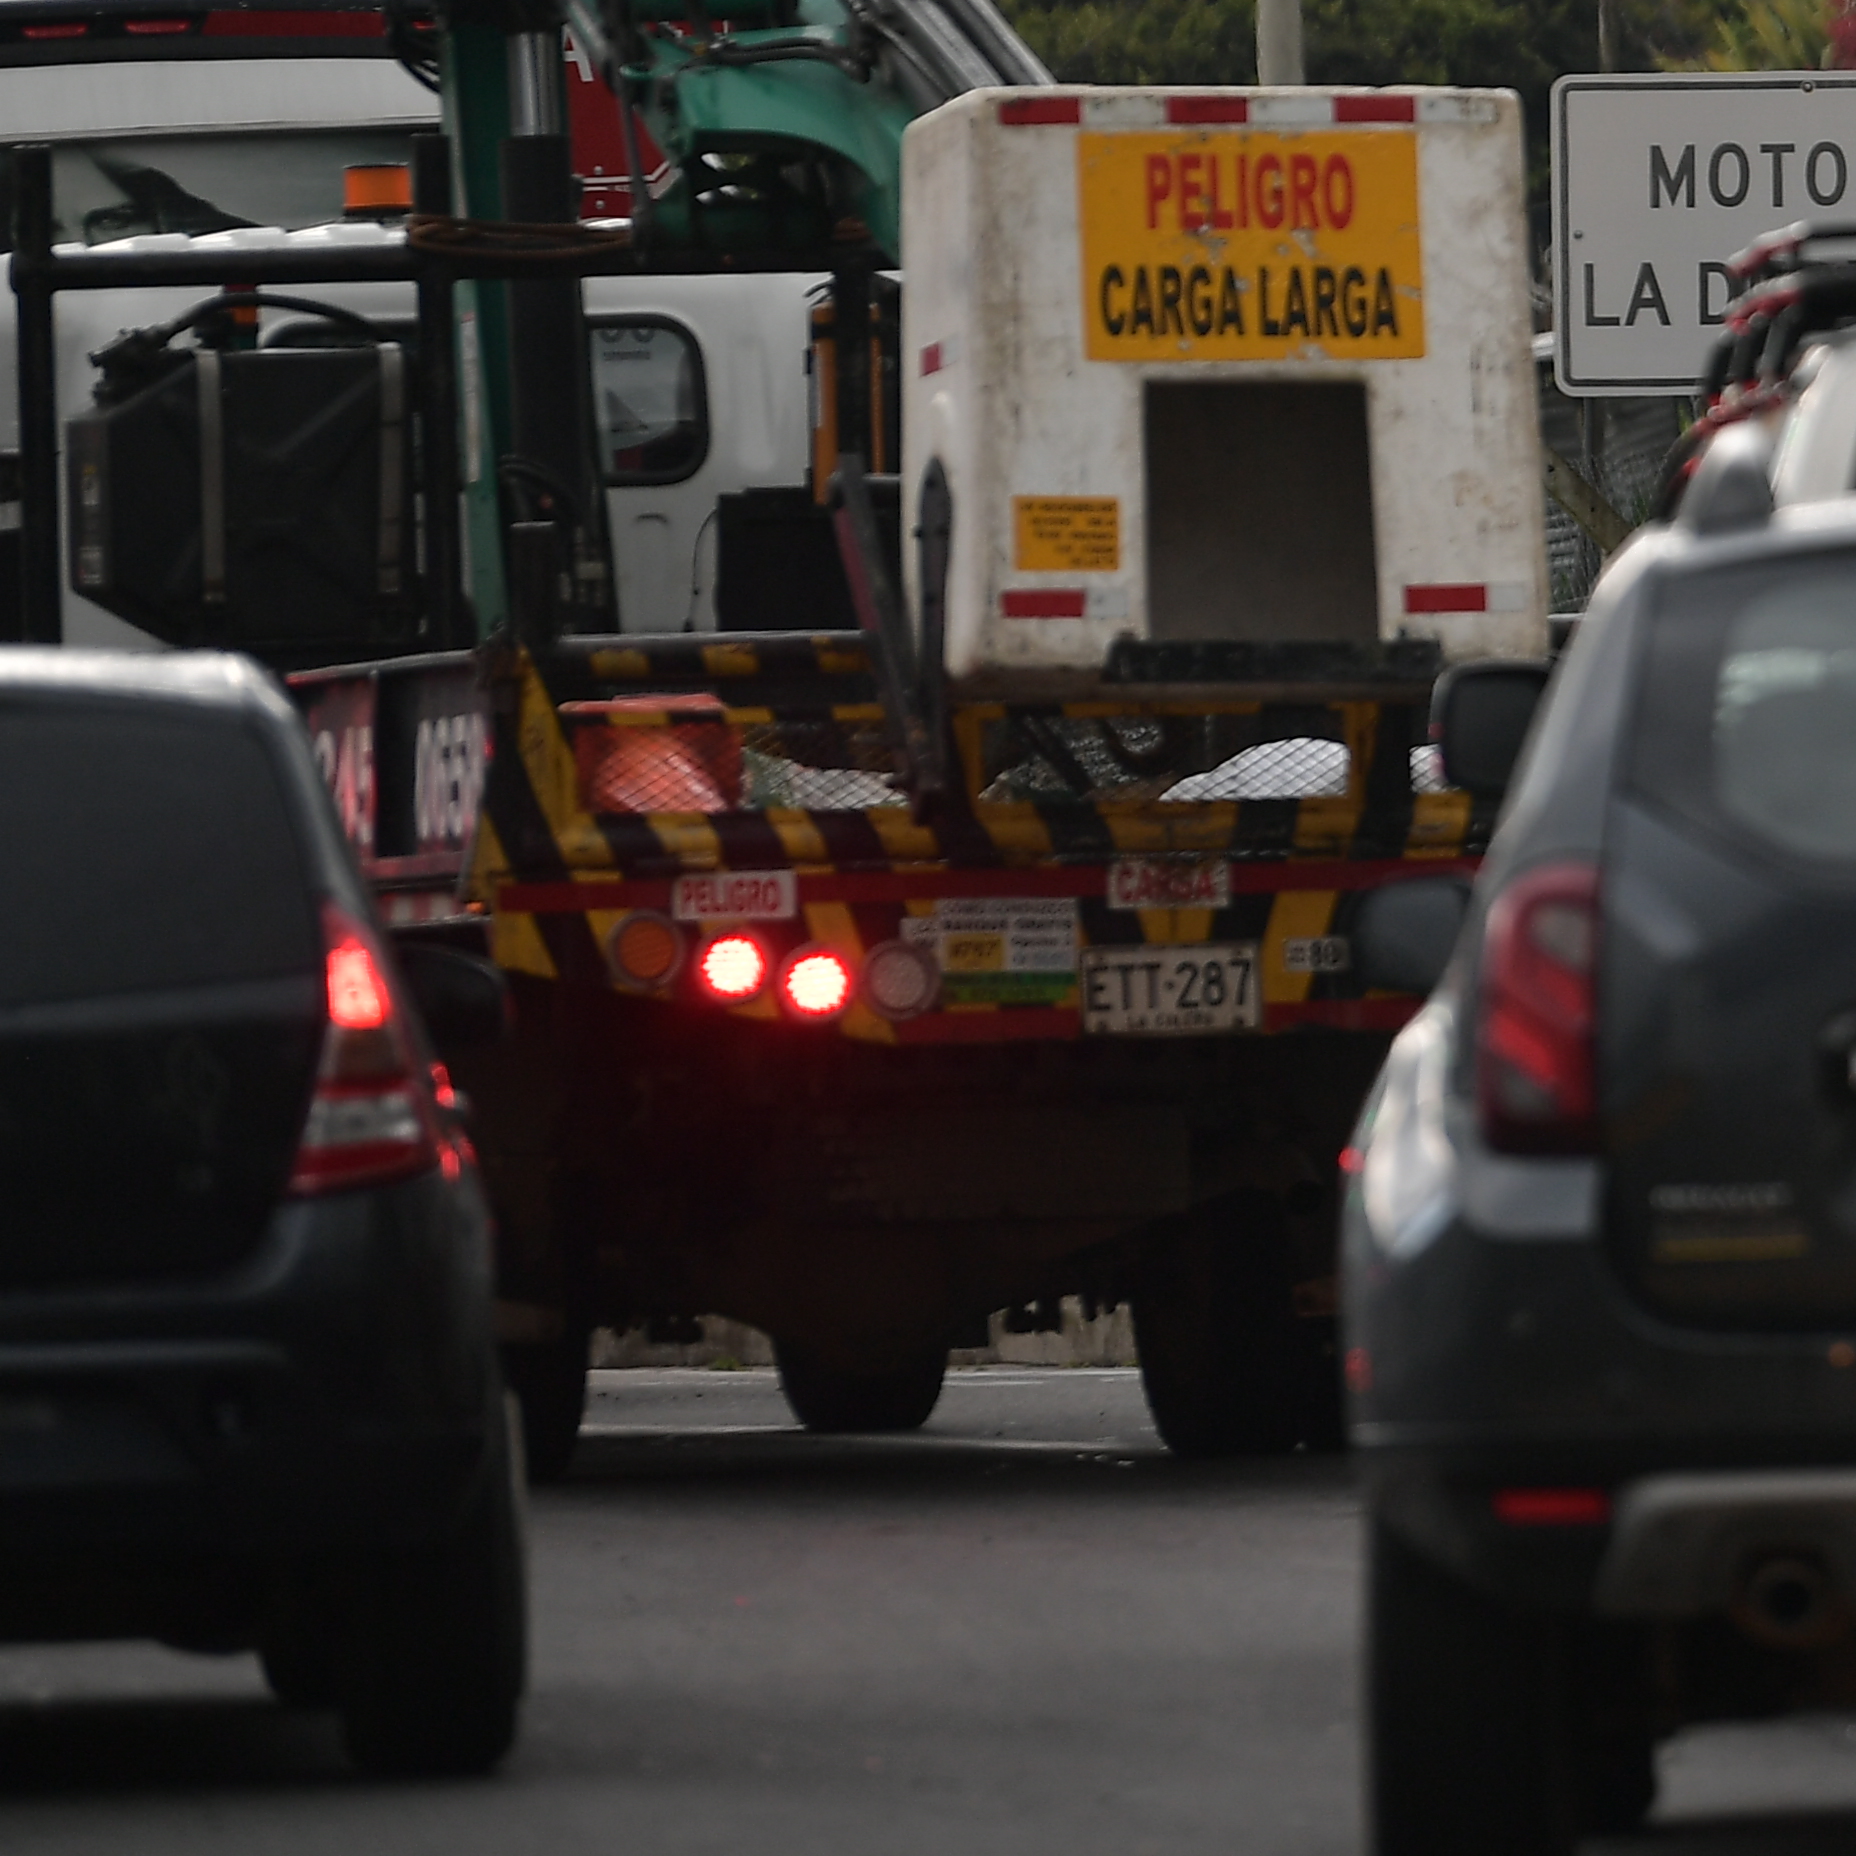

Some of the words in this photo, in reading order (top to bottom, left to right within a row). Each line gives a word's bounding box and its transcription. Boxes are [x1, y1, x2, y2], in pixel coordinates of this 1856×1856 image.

[1144, 152, 1354, 231] PELIGRO
[1101, 265, 1245, 338] CARGA
[1256, 266, 1399, 338] LARGA
[1585, 261, 1671, 327] LA
[680, 879, 779, 913] PELIGRO
